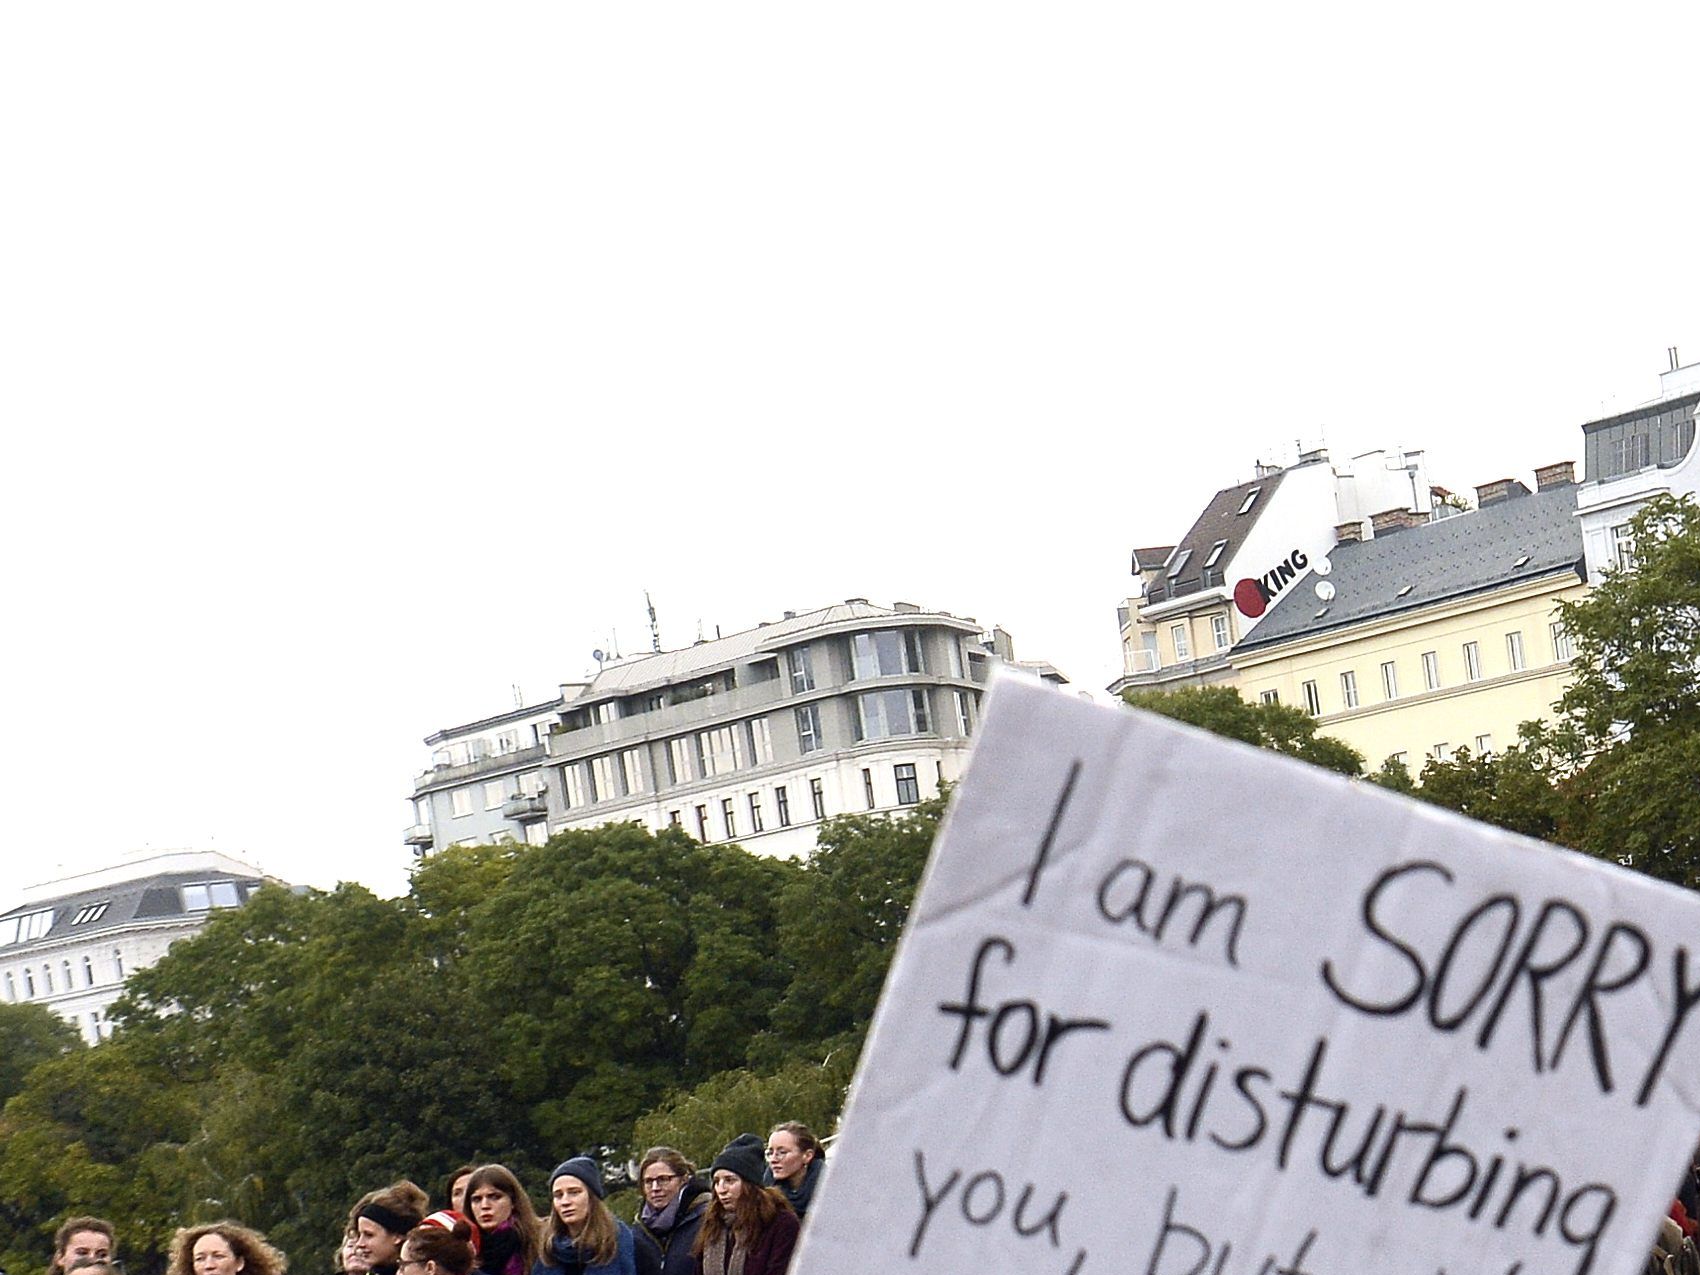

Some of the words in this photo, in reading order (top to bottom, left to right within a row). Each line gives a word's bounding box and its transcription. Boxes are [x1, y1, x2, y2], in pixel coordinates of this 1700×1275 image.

[1255, 549, 1308, 605] KING
[1020, 758, 1082, 908] I
[1094, 857, 1248, 966] am
[935, 934, 1112, 1088] for
